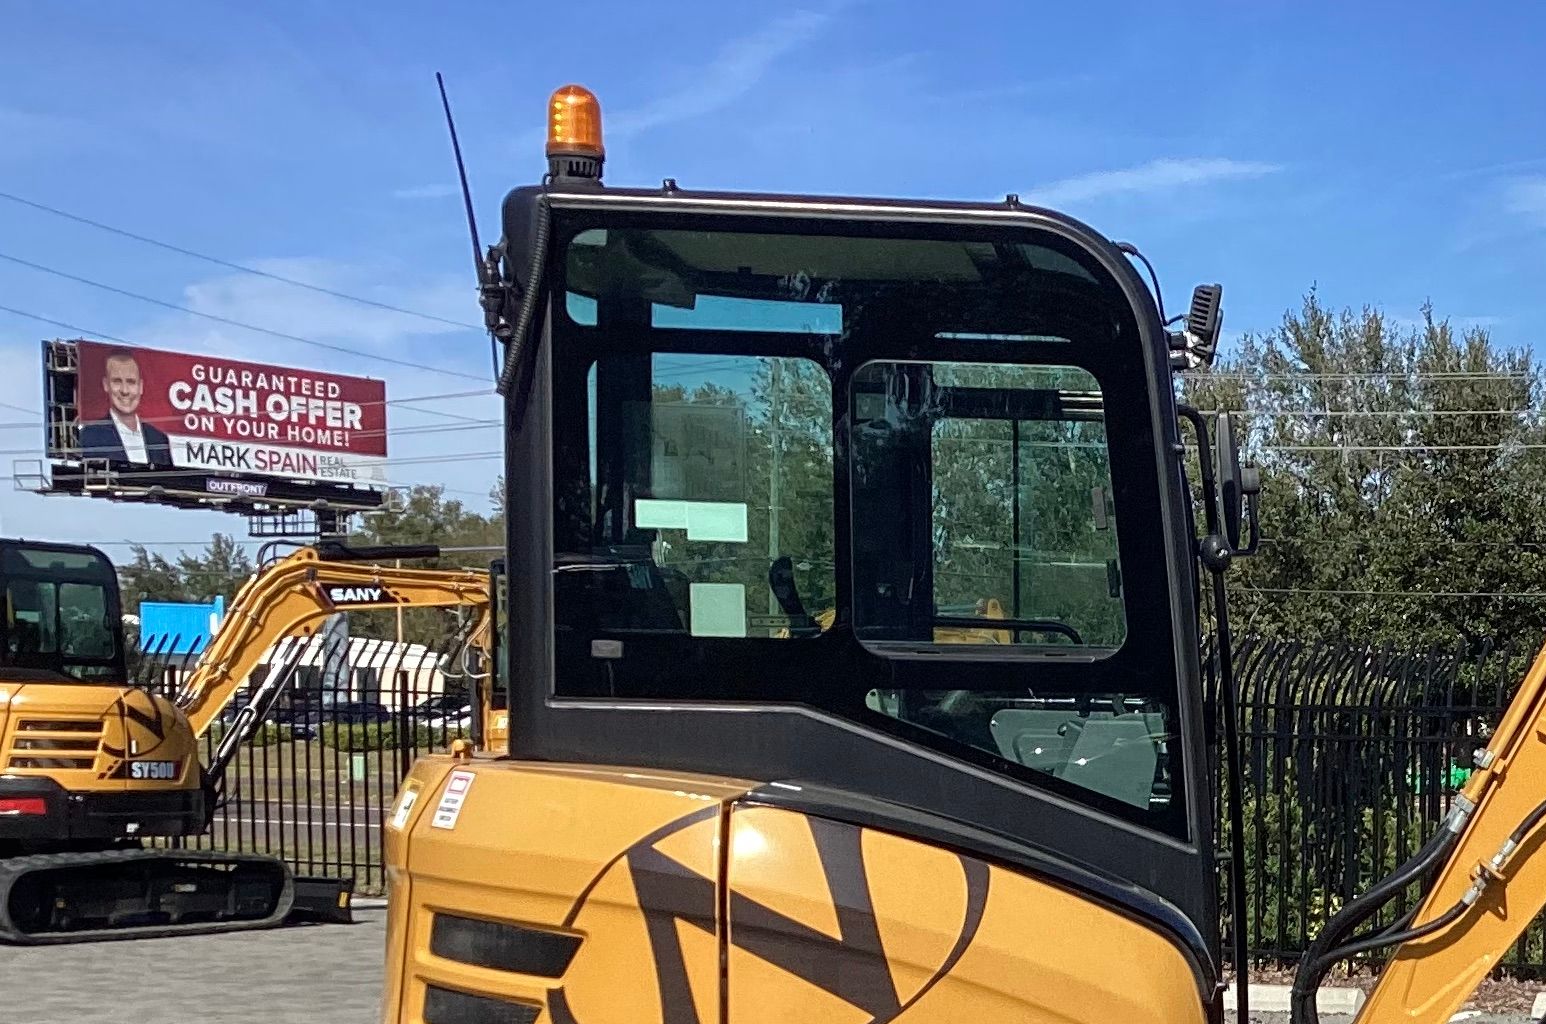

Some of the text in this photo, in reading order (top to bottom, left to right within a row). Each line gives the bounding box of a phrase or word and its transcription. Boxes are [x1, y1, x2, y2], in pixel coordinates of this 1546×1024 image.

[191, 364, 340, 398] GUARANTEED
[169, 381, 362, 430] CASH OFFER
[184, 414, 350, 447] ON YOUR HOME!
[186, 442, 317, 476] MARK SPAIN
[320, 455, 345, 467] REAL
[320, 467, 357, 479] ESTATE
[209, 480, 266, 494] OUTFRONT
[330, 588, 381, 601] SANY
